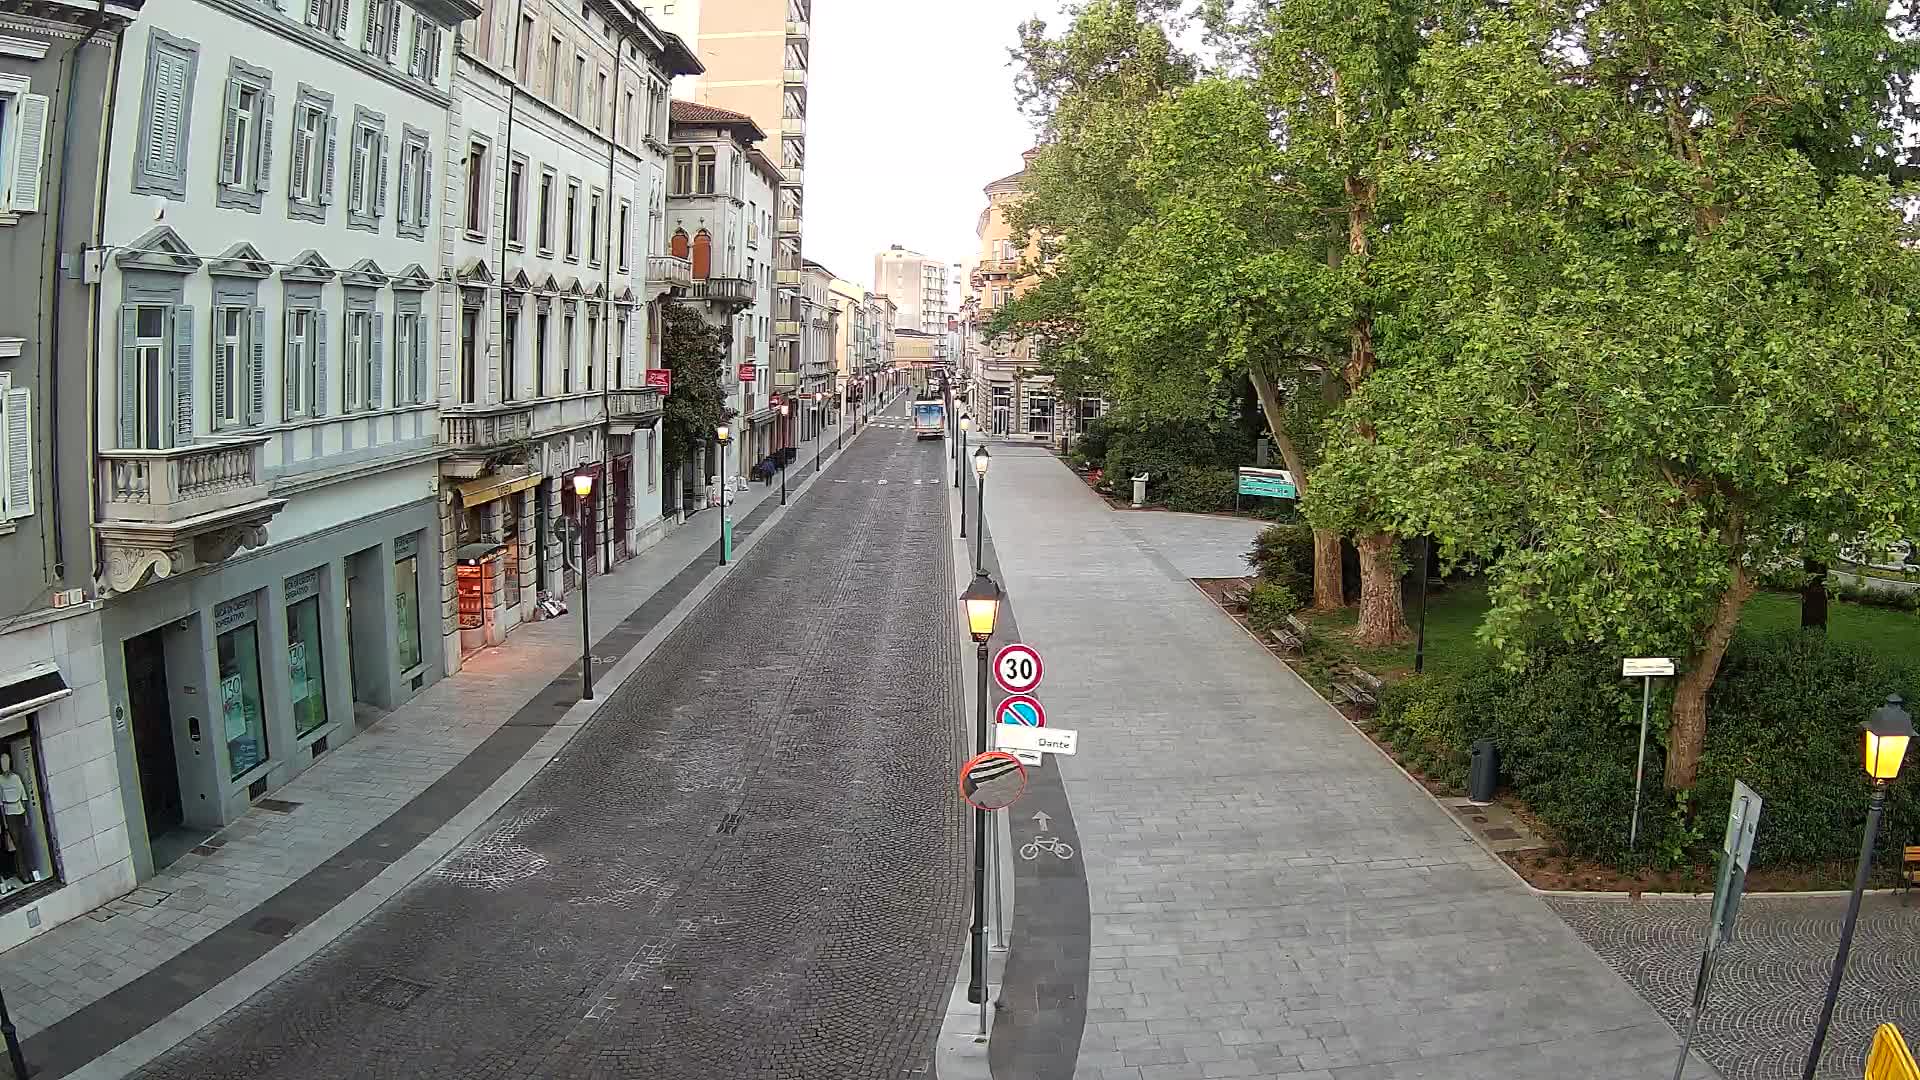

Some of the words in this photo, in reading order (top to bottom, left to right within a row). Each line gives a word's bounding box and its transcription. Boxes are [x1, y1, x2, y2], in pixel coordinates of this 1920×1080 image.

[1006, 658, 1032, 679] 30
[221, 677, 241, 701] 130
[1038, 738, 1070, 749] Dante
